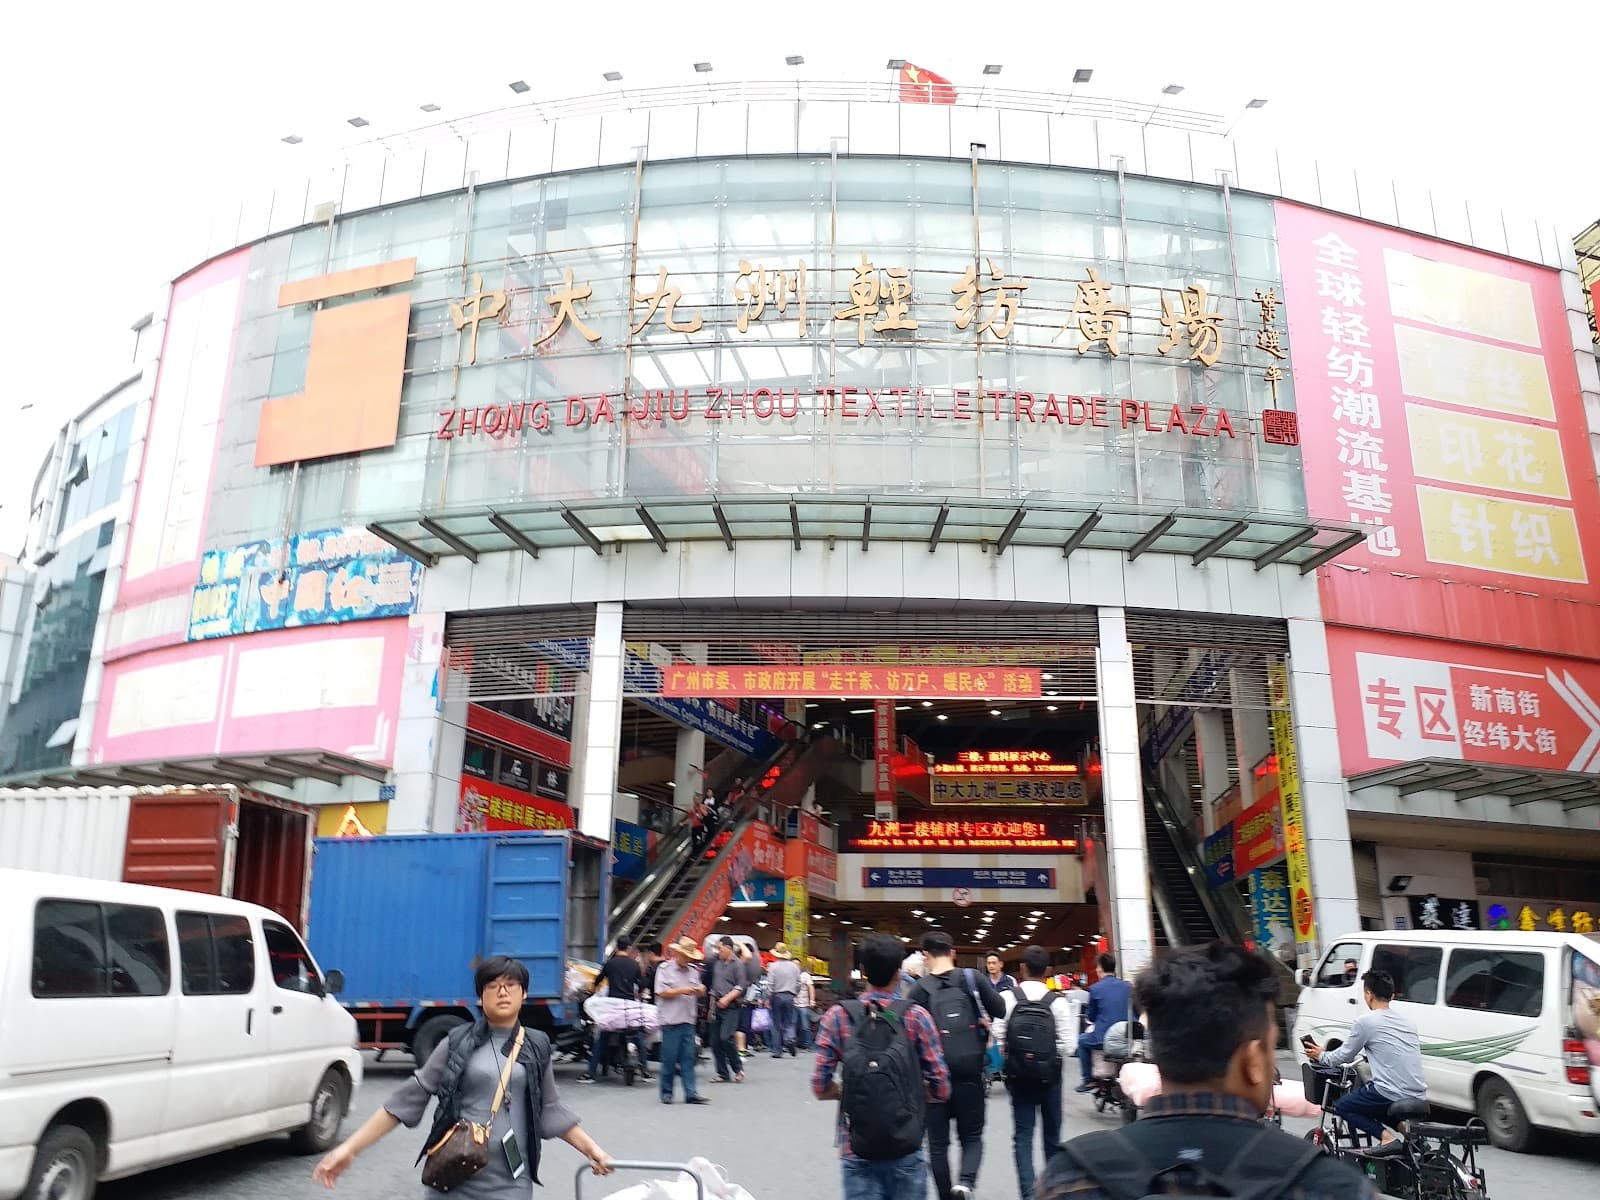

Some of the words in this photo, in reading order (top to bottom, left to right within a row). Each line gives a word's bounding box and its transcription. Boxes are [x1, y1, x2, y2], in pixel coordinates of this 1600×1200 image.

[437, 401, 549, 439] ZHONG
[565, 394, 614, 427] DA
[631, 389, 689, 421] JIU
[704, 387, 799, 419] ZHOU
[816, 386, 972, 420] TEXTILE
[988, 390, 1110, 428] TRADE
[1121, 399, 1235, 439] PLAZA
[1312, 231, 1401, 557] 全球轻纺潮流基地
[1440, 422, 1545, 485] 印花
[1450, 502, 1560, 566] 针织
[1365, 677, 1458, 742] 专区
[1469, 683, 1540, 718] 新南街
[1463, 719, 1557, 755] 经纬大街
[935, 781, 1083, 798] 中大九洲二楼欢迎您
